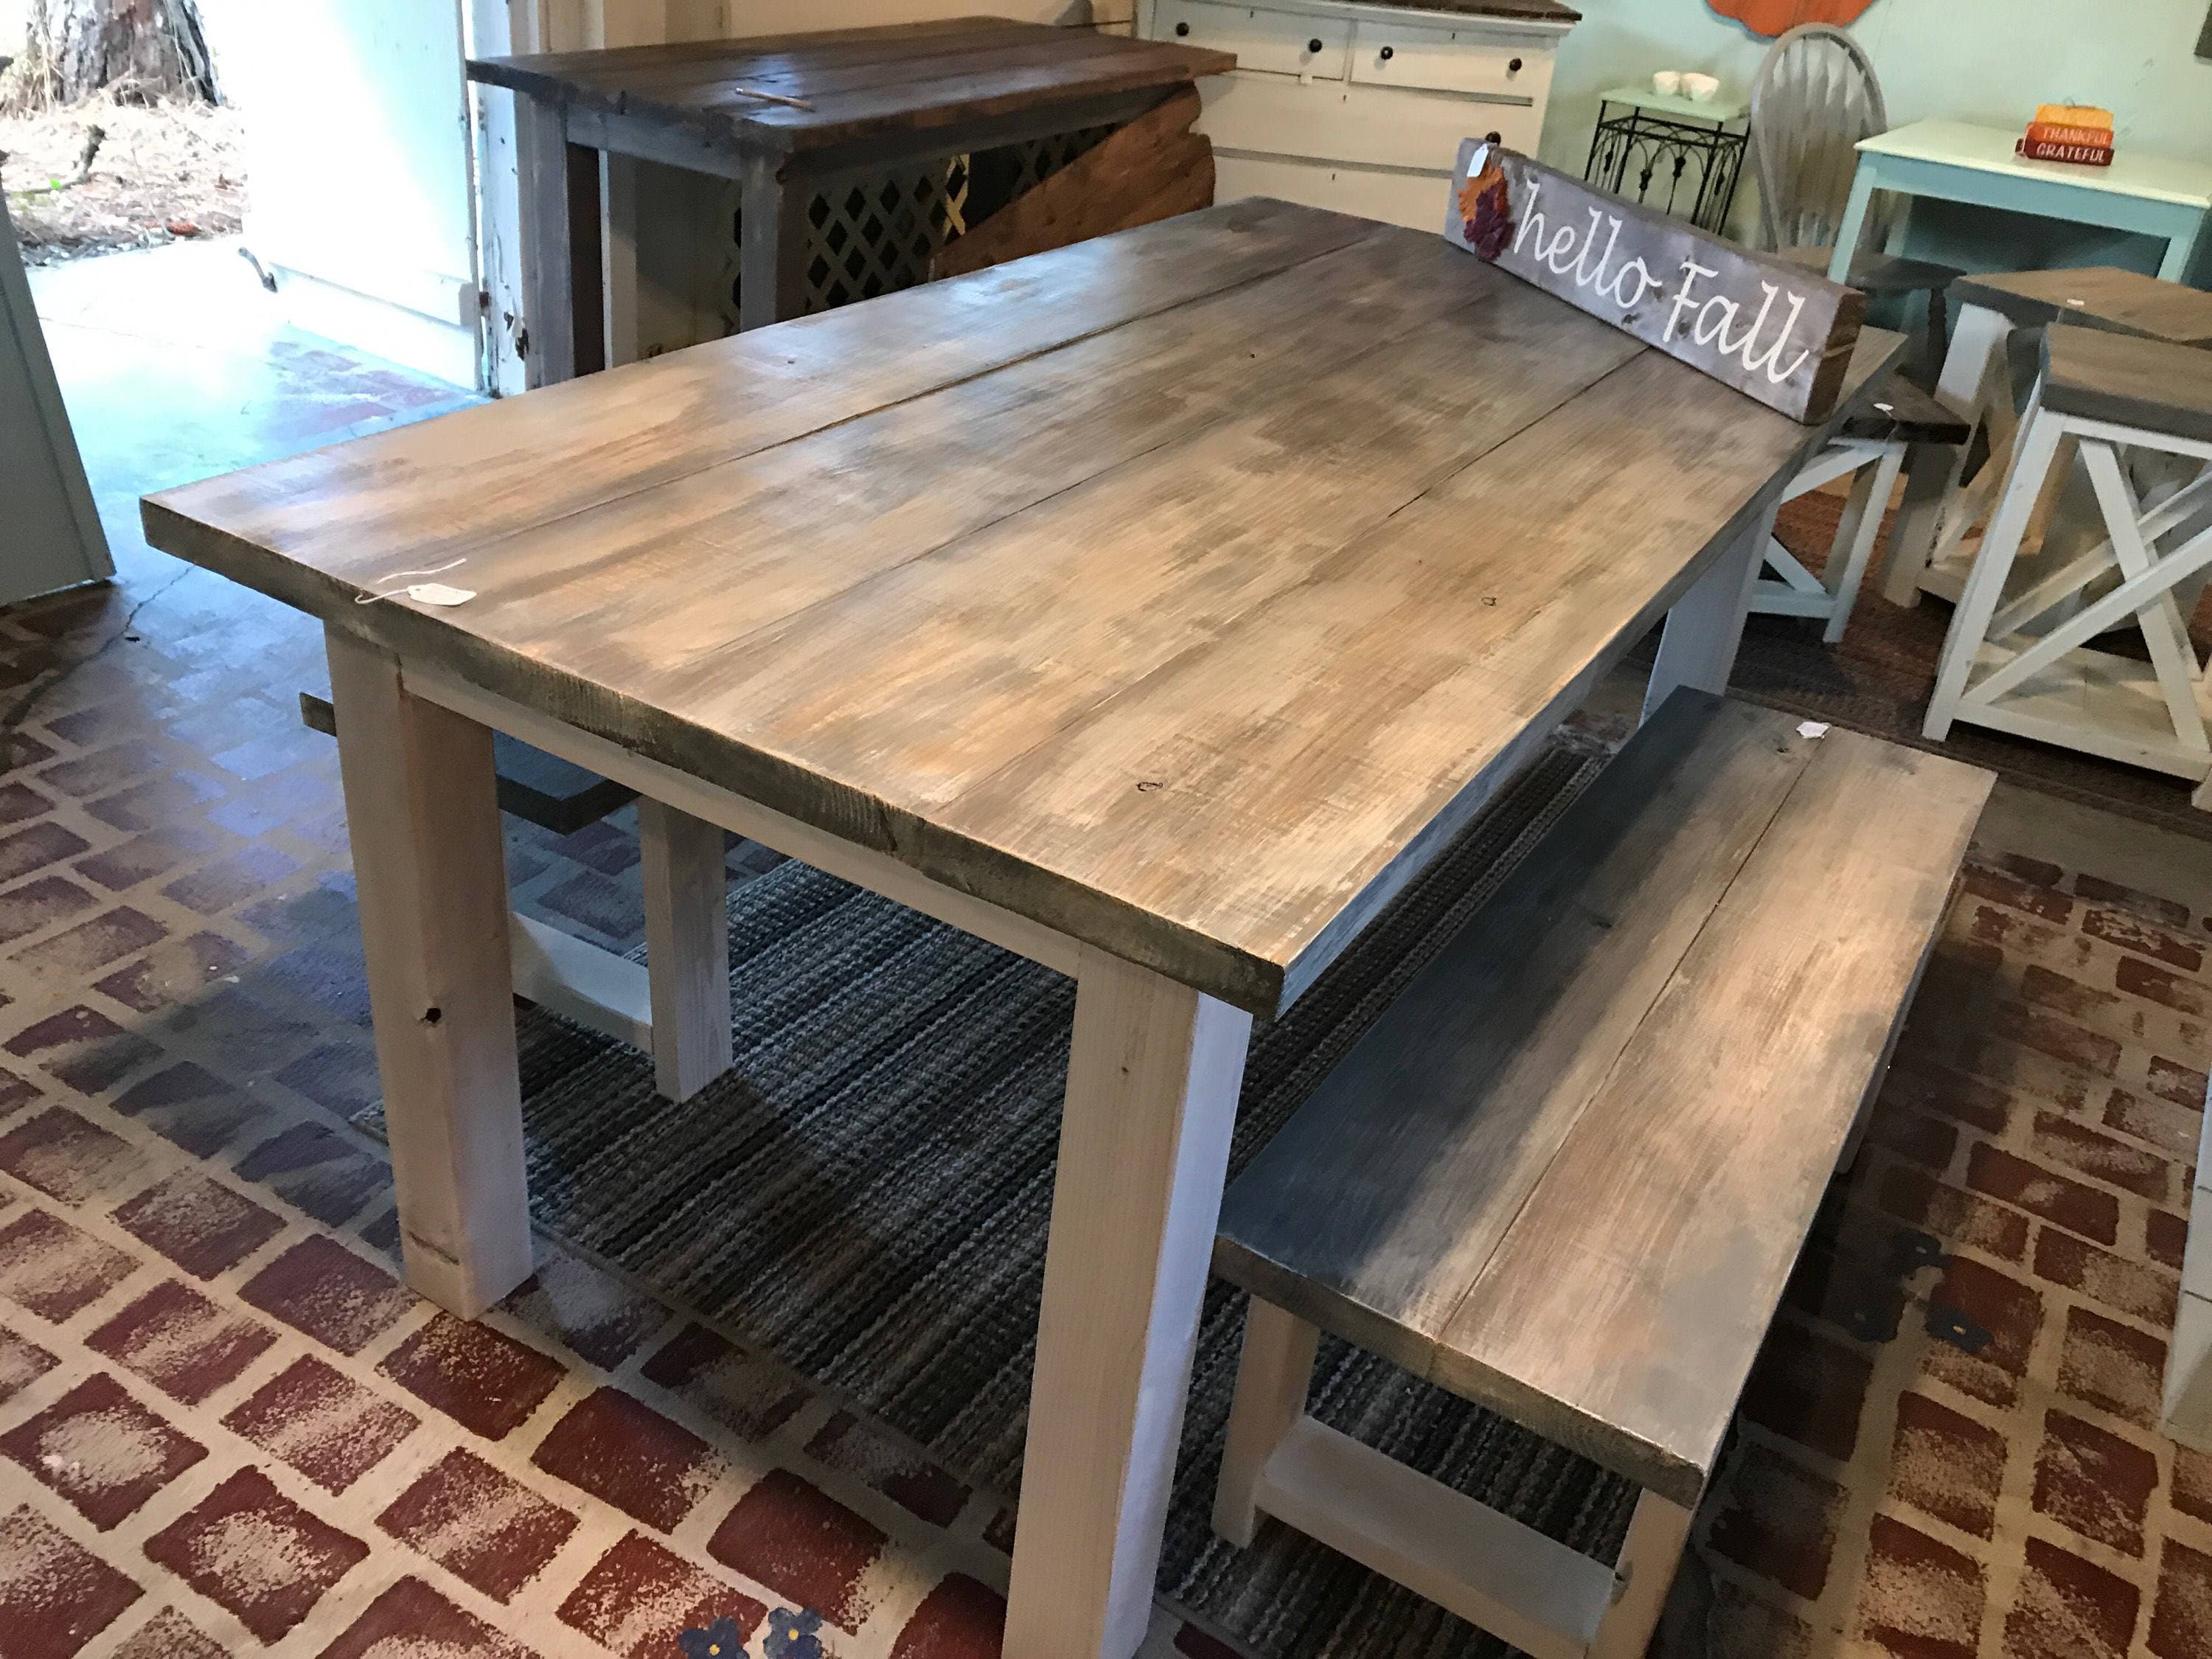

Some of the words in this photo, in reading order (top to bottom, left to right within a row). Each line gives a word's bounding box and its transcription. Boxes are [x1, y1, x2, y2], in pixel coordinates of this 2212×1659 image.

[2043, 127, 2109, 145] THANKFUL
[2037, 142, 2106, 163] GRATEFUL
[1514, 180, 1662, 308] hello
[1663, 261, 1809, 383] Fall
